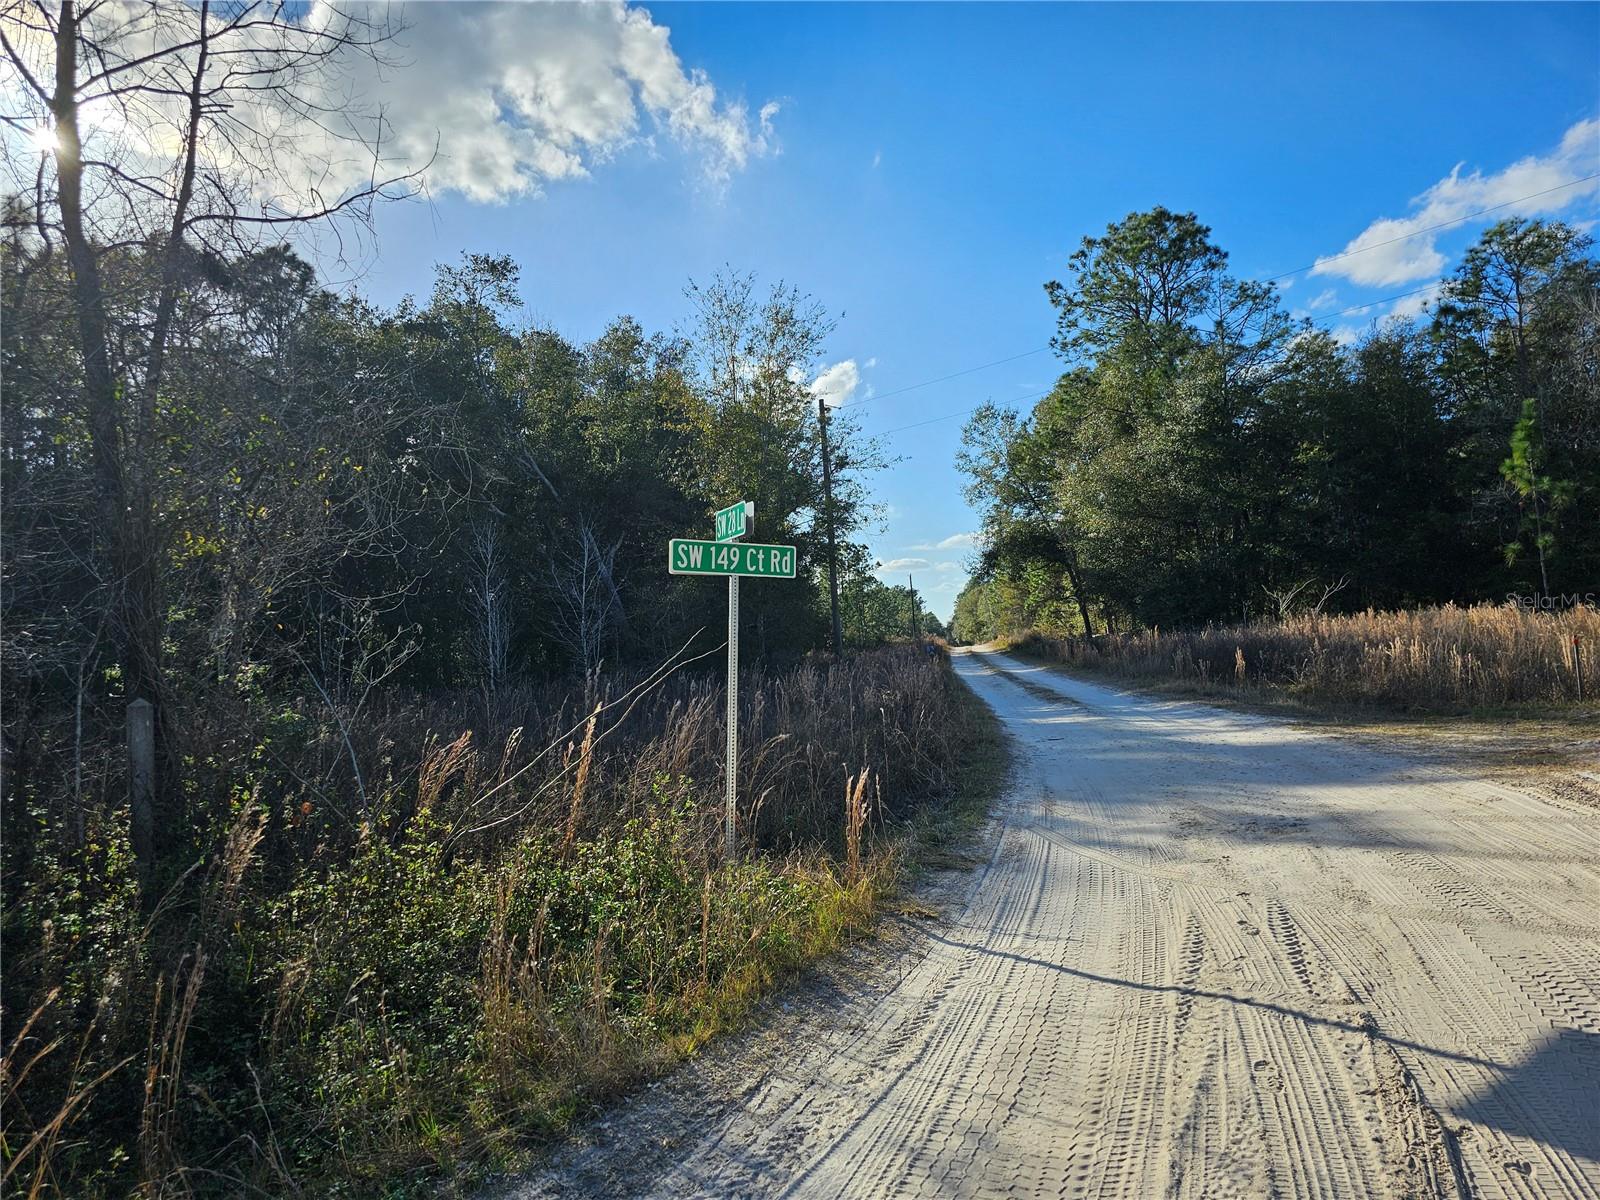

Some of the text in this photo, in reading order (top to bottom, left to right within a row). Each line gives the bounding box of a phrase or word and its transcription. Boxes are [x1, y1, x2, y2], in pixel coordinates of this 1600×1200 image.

[717, 513, 727, 538] SW
[728, 510, 736, 535] 28
[677, 543, 791, 574] SW 149 Ct Rd
